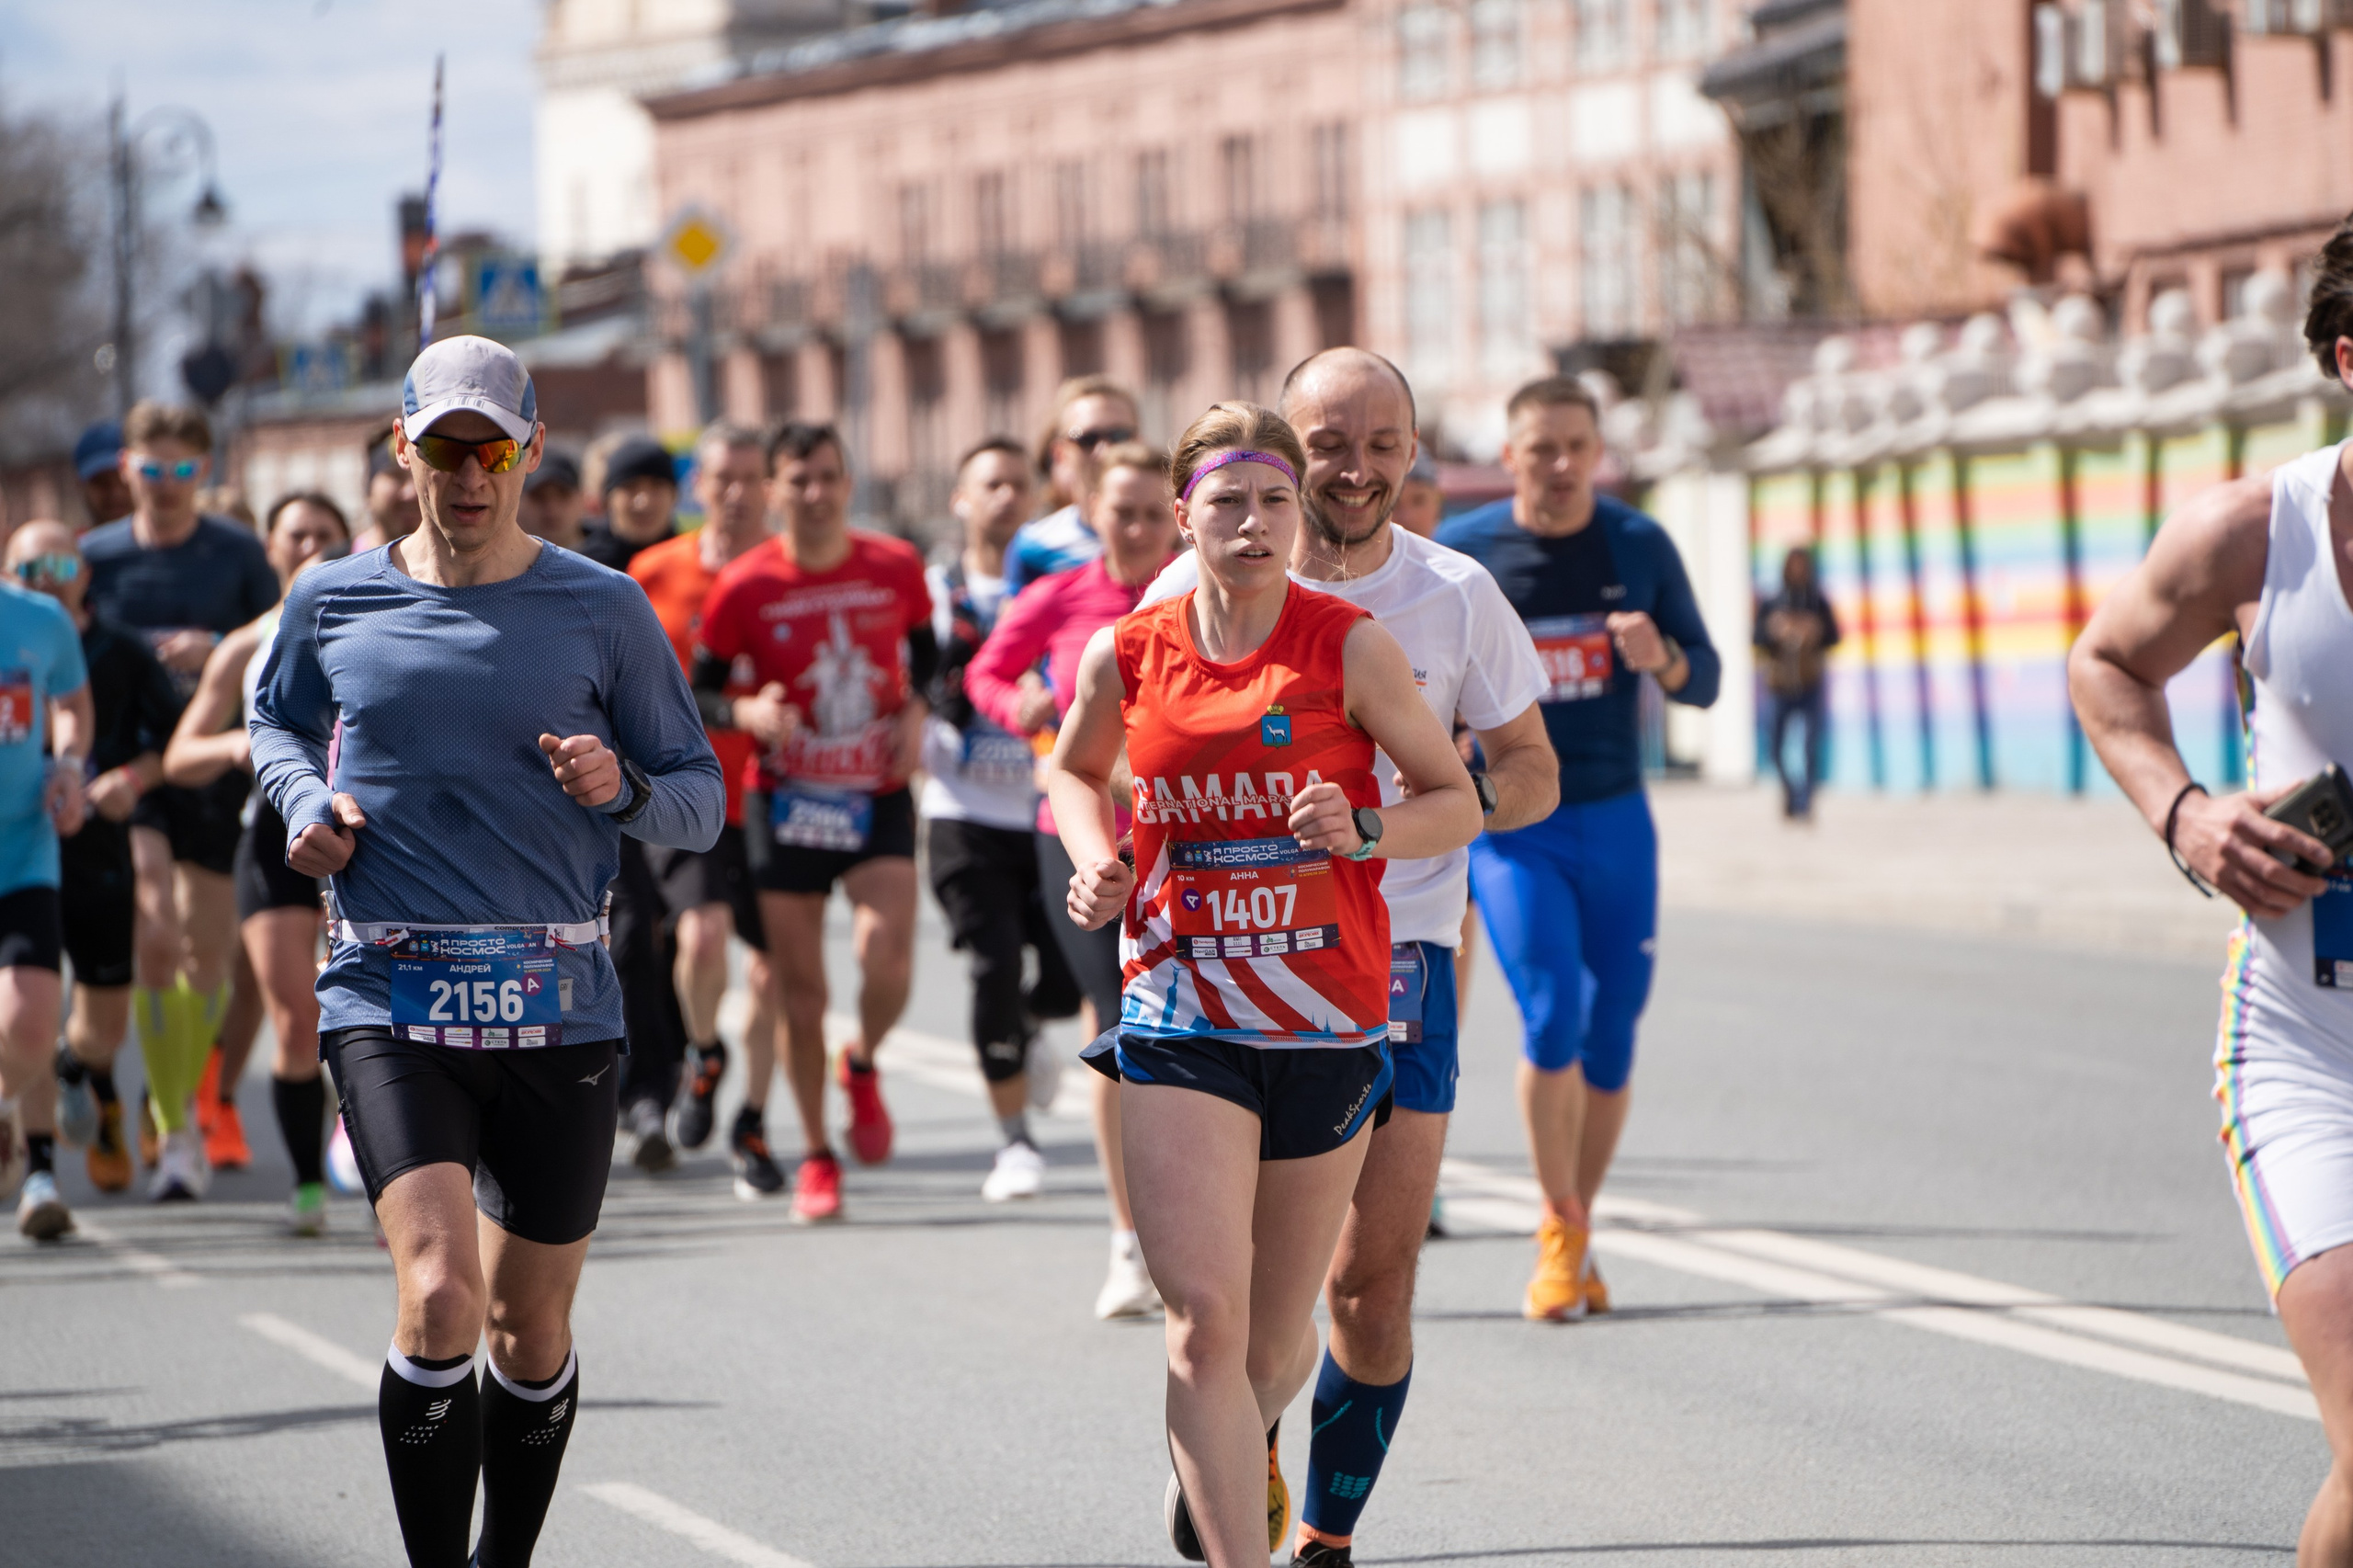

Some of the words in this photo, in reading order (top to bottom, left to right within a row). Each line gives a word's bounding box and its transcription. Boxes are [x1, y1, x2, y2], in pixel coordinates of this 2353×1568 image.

[1139, 796, 1241, 811] NTERNATIONAL
[1212, 847, 1222, 856] Я
[1223, 844, 1279, 854] ПРОСТО
[1213, 852, 1279, 863] КОСМОС
[1230, 871, 1259, 881] АННА
[1206, 884, 1298, 931] 1407
[450, 937, 506, 946] ПРОСТО
[440, 946, 506, 955] КОСМОС
[449, 963, 491, 973] АНДРЕЙ
[428, 979, 524, 1022] 2156
